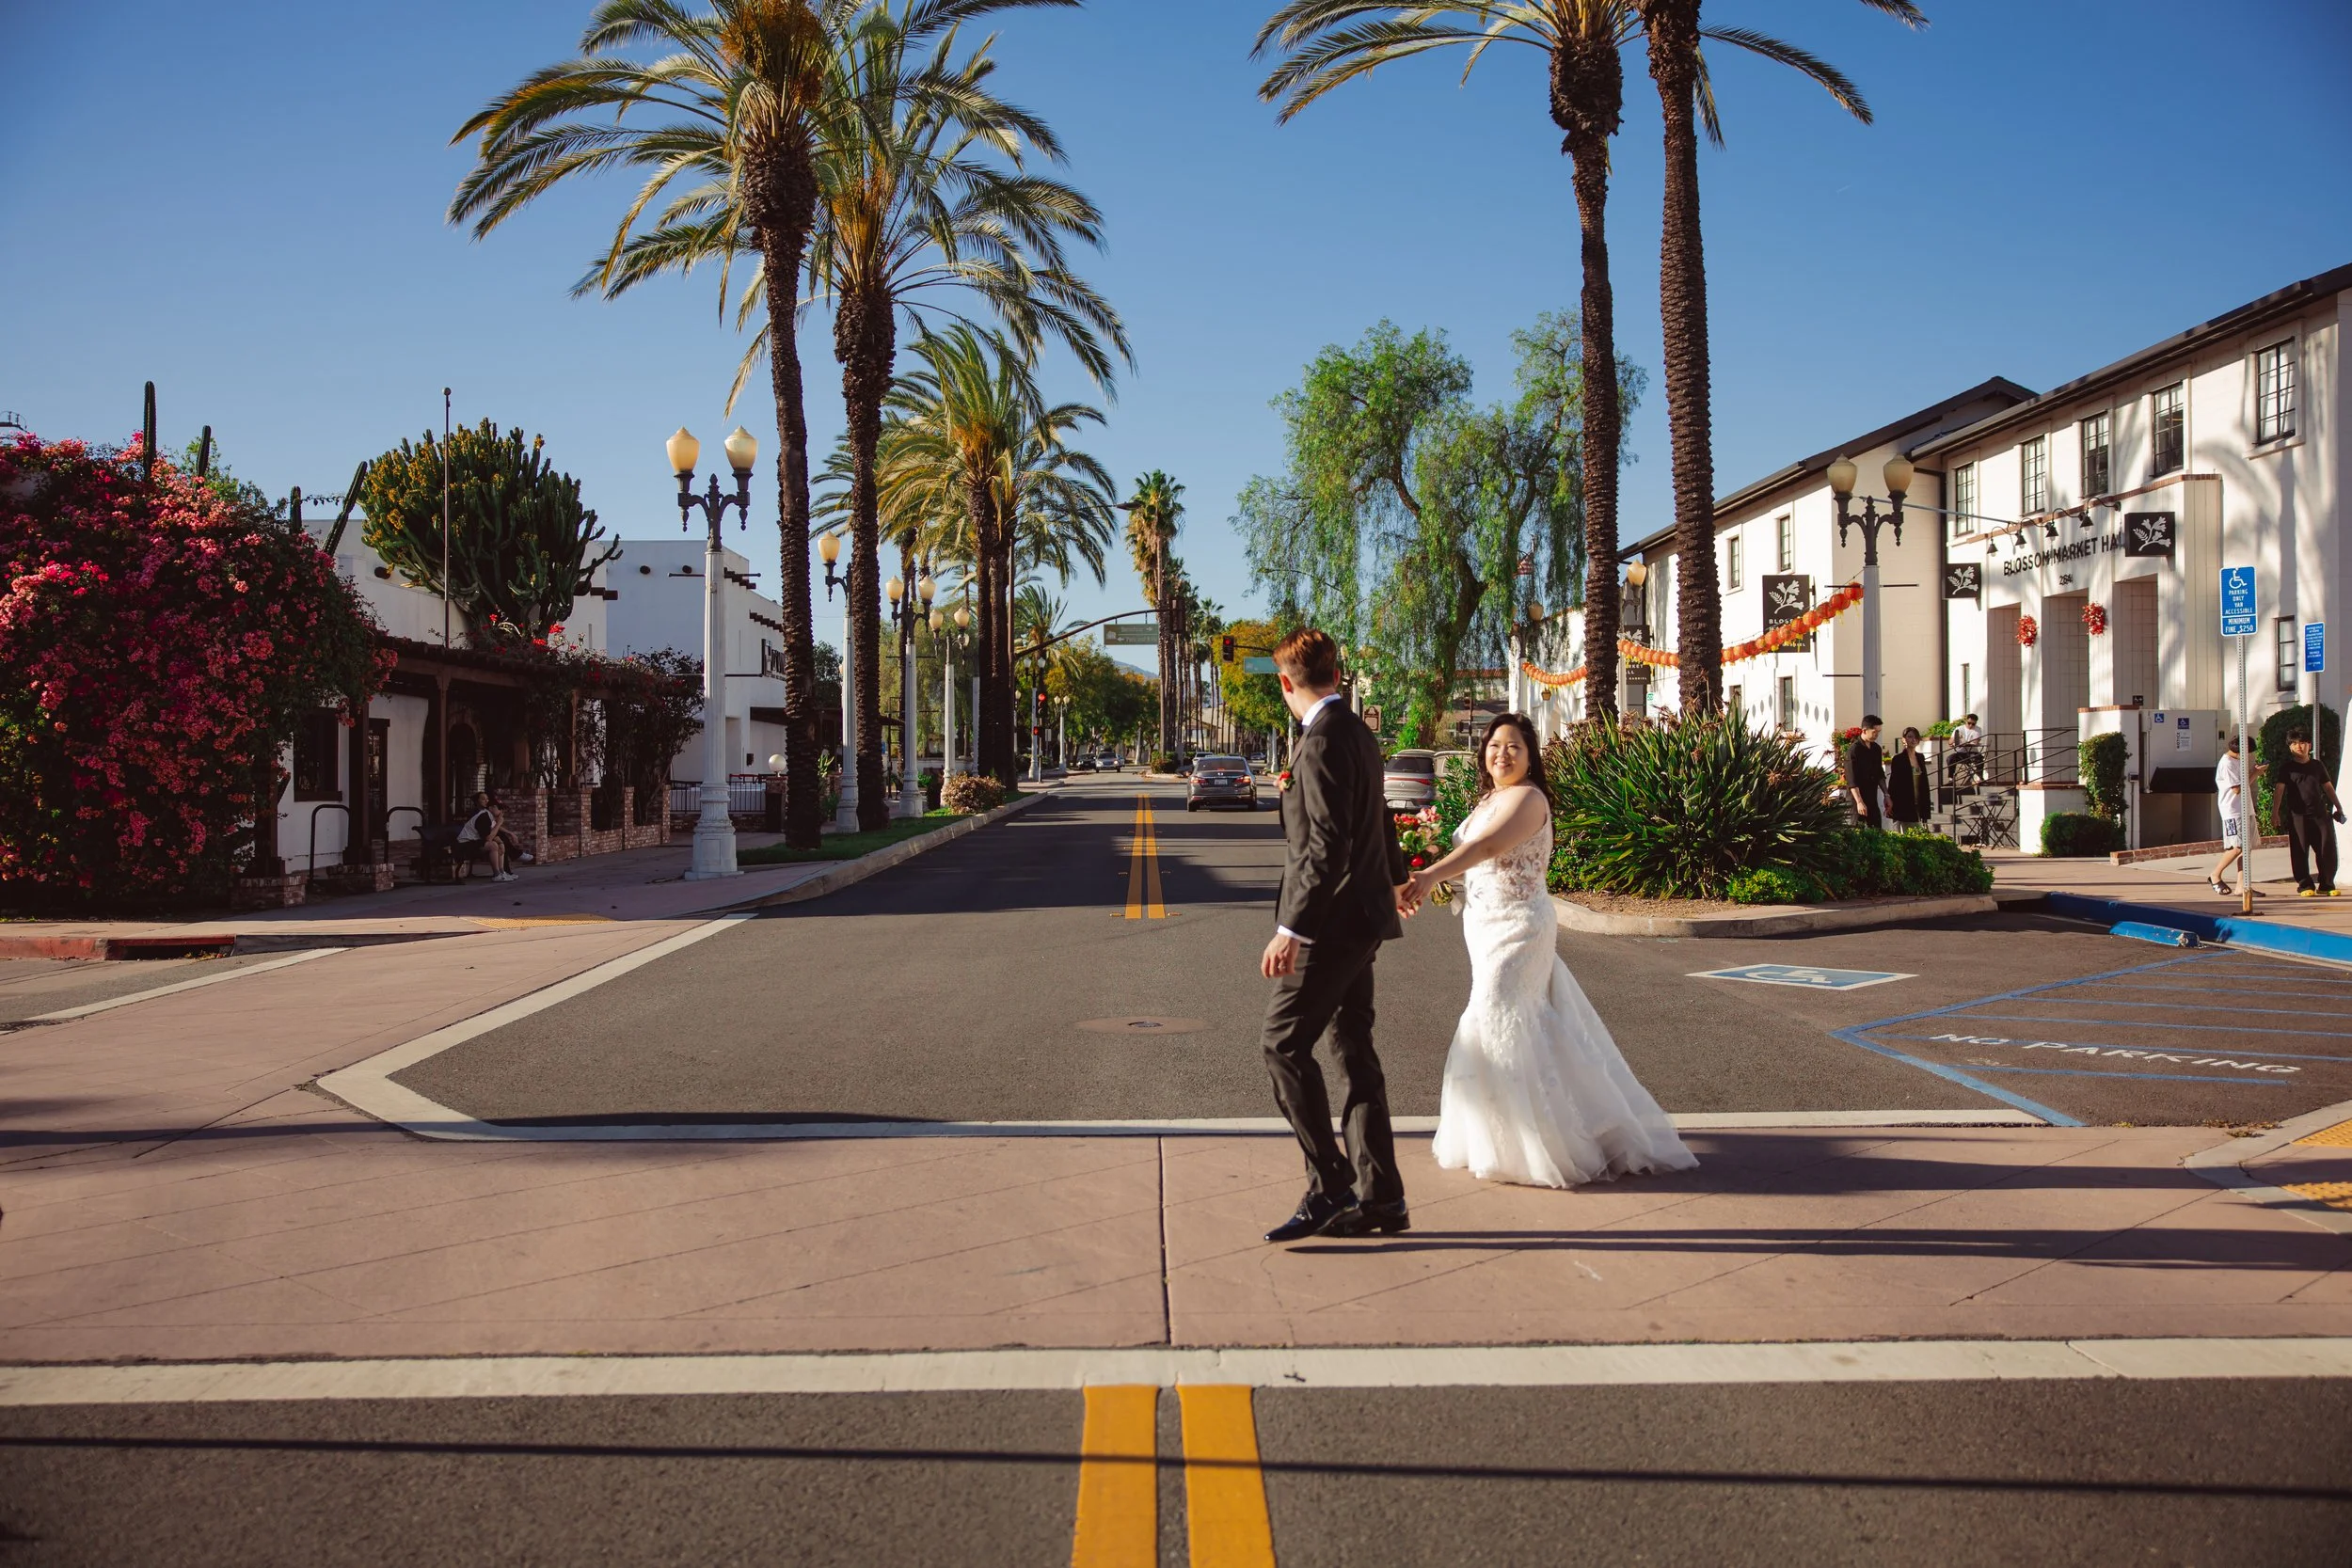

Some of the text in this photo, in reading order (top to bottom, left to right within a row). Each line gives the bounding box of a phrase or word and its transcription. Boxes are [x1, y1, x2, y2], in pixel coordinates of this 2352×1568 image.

[2003, 531, 2124, 576] BLOSSOM MARKET HAL
[2239, 625, 2254, 633] $250
[1930, 1034, 2301, 1072] NO PARKING
